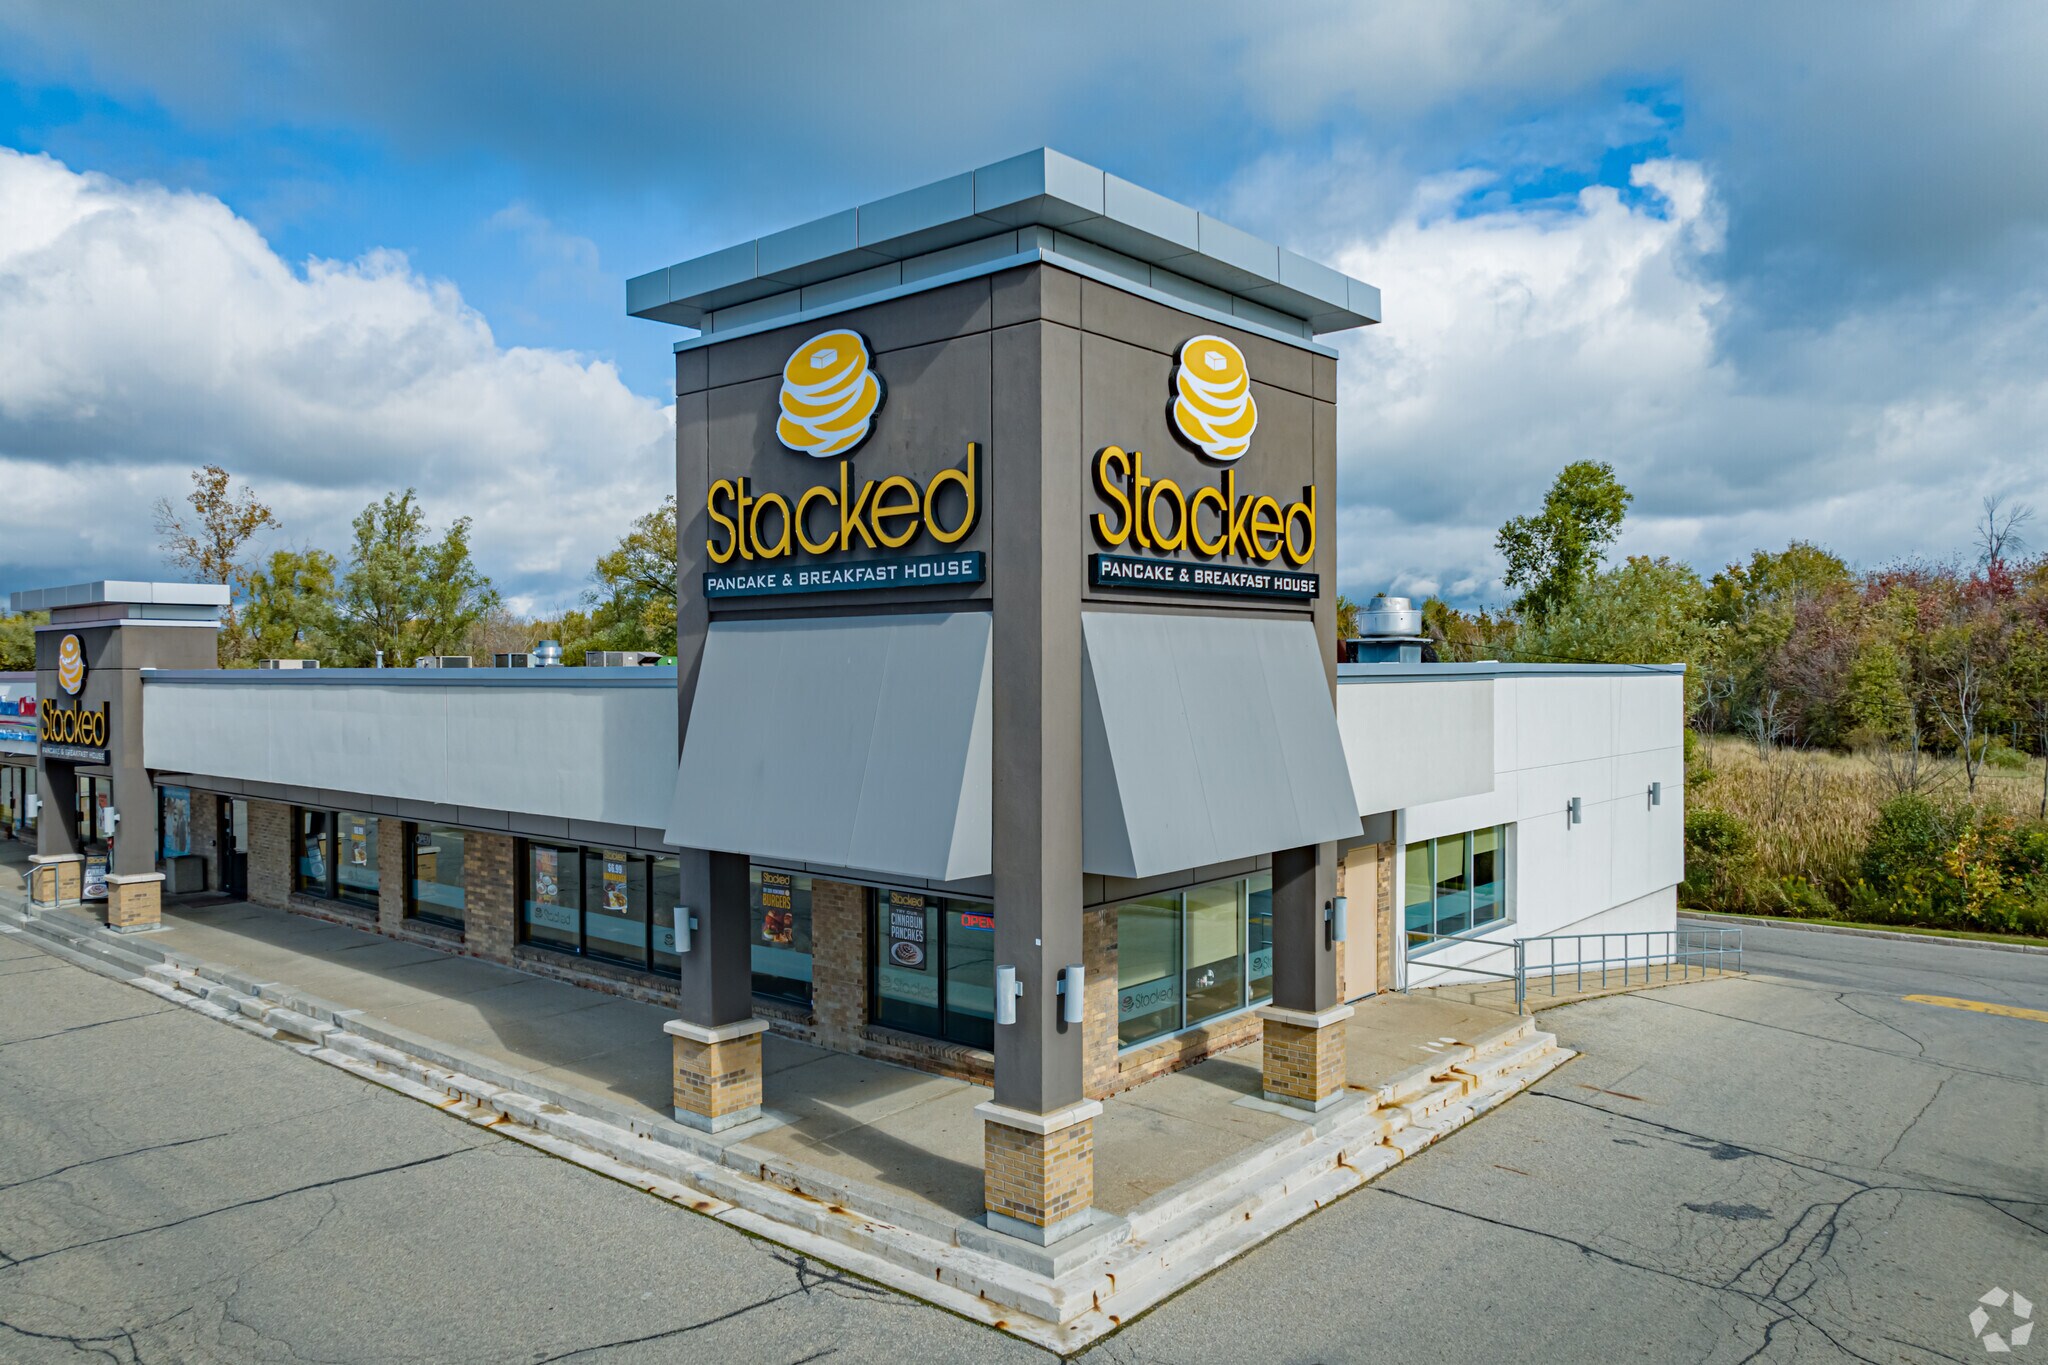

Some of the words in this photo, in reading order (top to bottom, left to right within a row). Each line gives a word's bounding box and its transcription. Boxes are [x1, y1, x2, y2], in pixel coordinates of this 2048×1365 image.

[706, 441, 977, 565] Stacked
[1096, 444, 1317, 565] Stacked
[707, 574, 777, 591] PANCAKE
[781, 572, 793, 587] &
[799, 565, 898, 586] BREAKFAST
[904, 559, 974, 579] HOUSE
[1101, 561, 1174, 582] PANCAKE
[1179, 569, 1190, 583] &
[1194, 569, 1271, 589] BREAKFAST
[1274, 577, 1316, 593] HOUSE
[41, 698, 105, 747] Stacked
[607, 863, 623, 874] $6.99
[762, 872, 791, 885] Stacked
[762, 893, 791, 909] BURGERS
[891, 892, 923, 908] Stacked
[891, 912, 923, 930] CINNABUN
[961, 913, 995, 929] OPEN
[891, 925, 924, 943] PANCAKES
[1135, 984, 1174, 1010] Stacked
